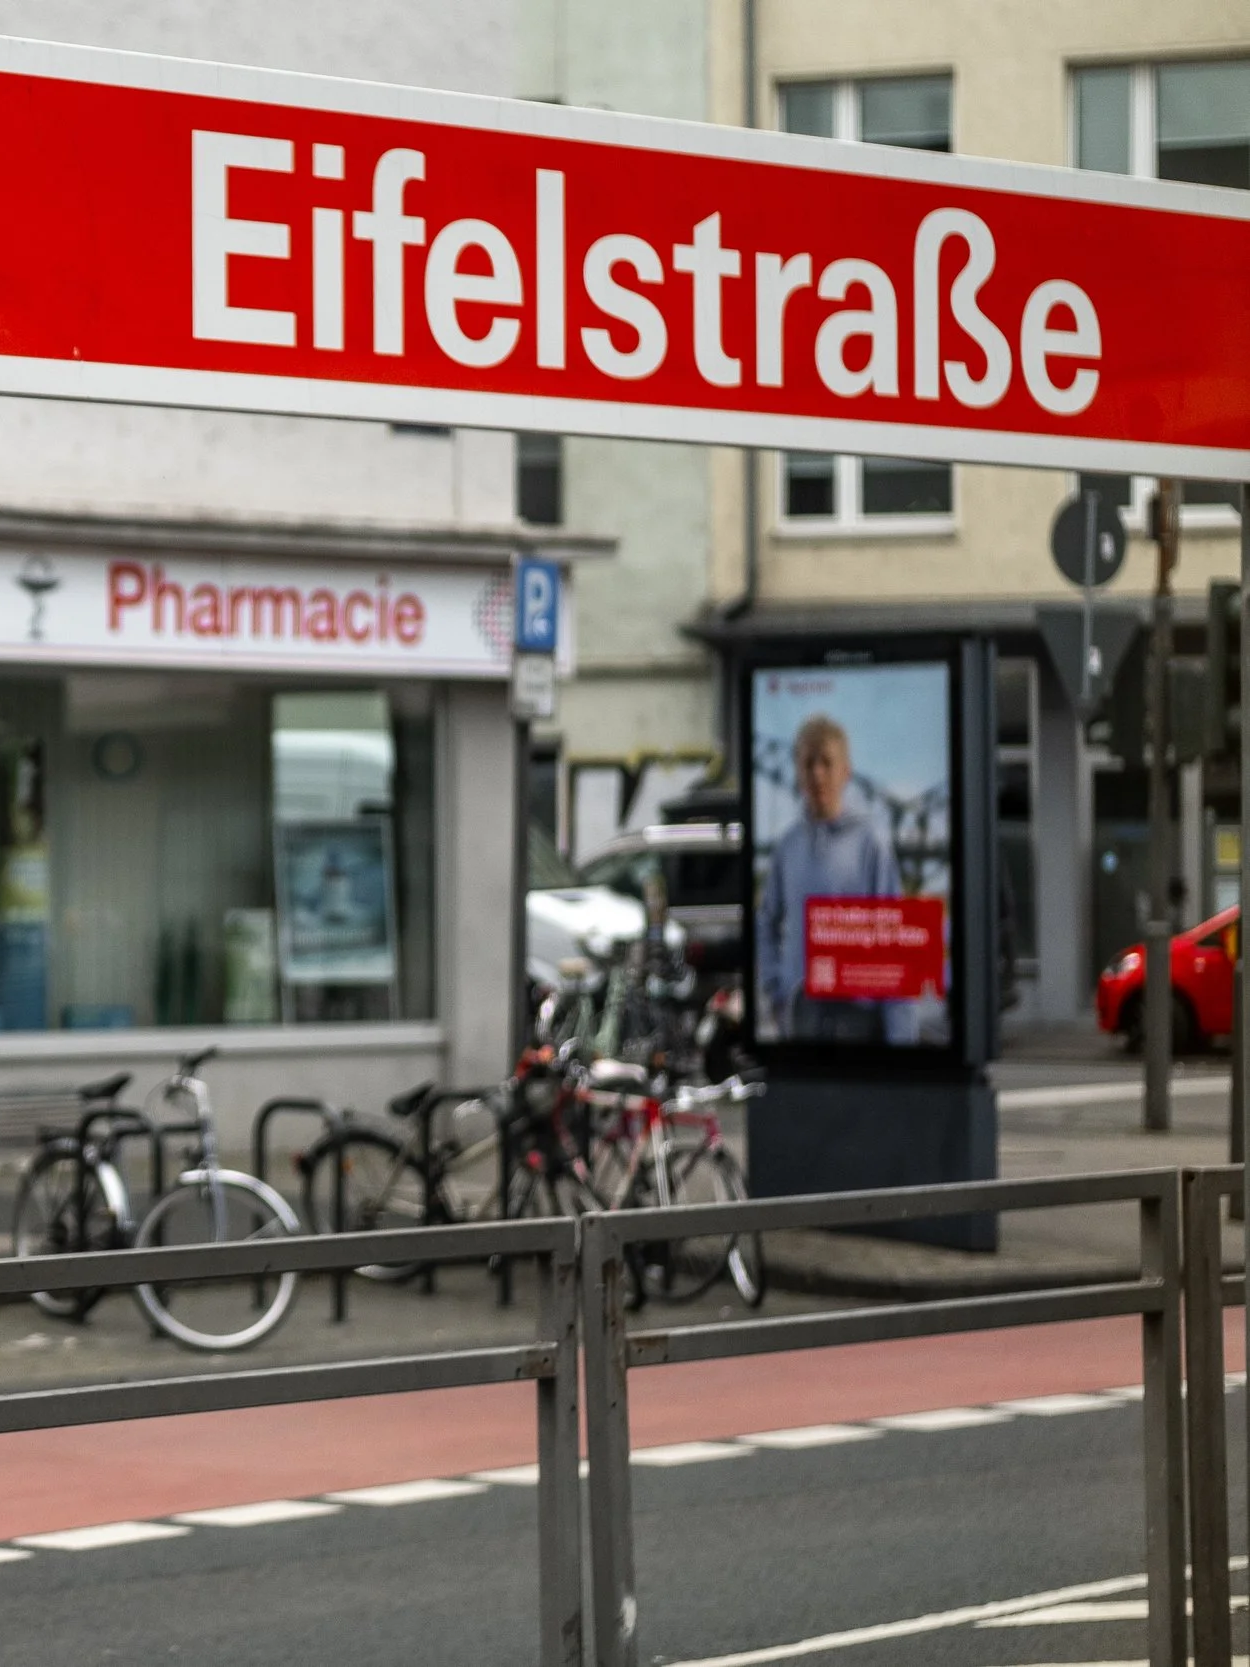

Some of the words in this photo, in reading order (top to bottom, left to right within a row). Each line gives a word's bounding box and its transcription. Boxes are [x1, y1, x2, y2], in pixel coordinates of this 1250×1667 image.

[191, 130, 1103, 416] Eifelstraße
[108, 561, 424, 645] Pharmacie
[524, 568, 551, 641] P
